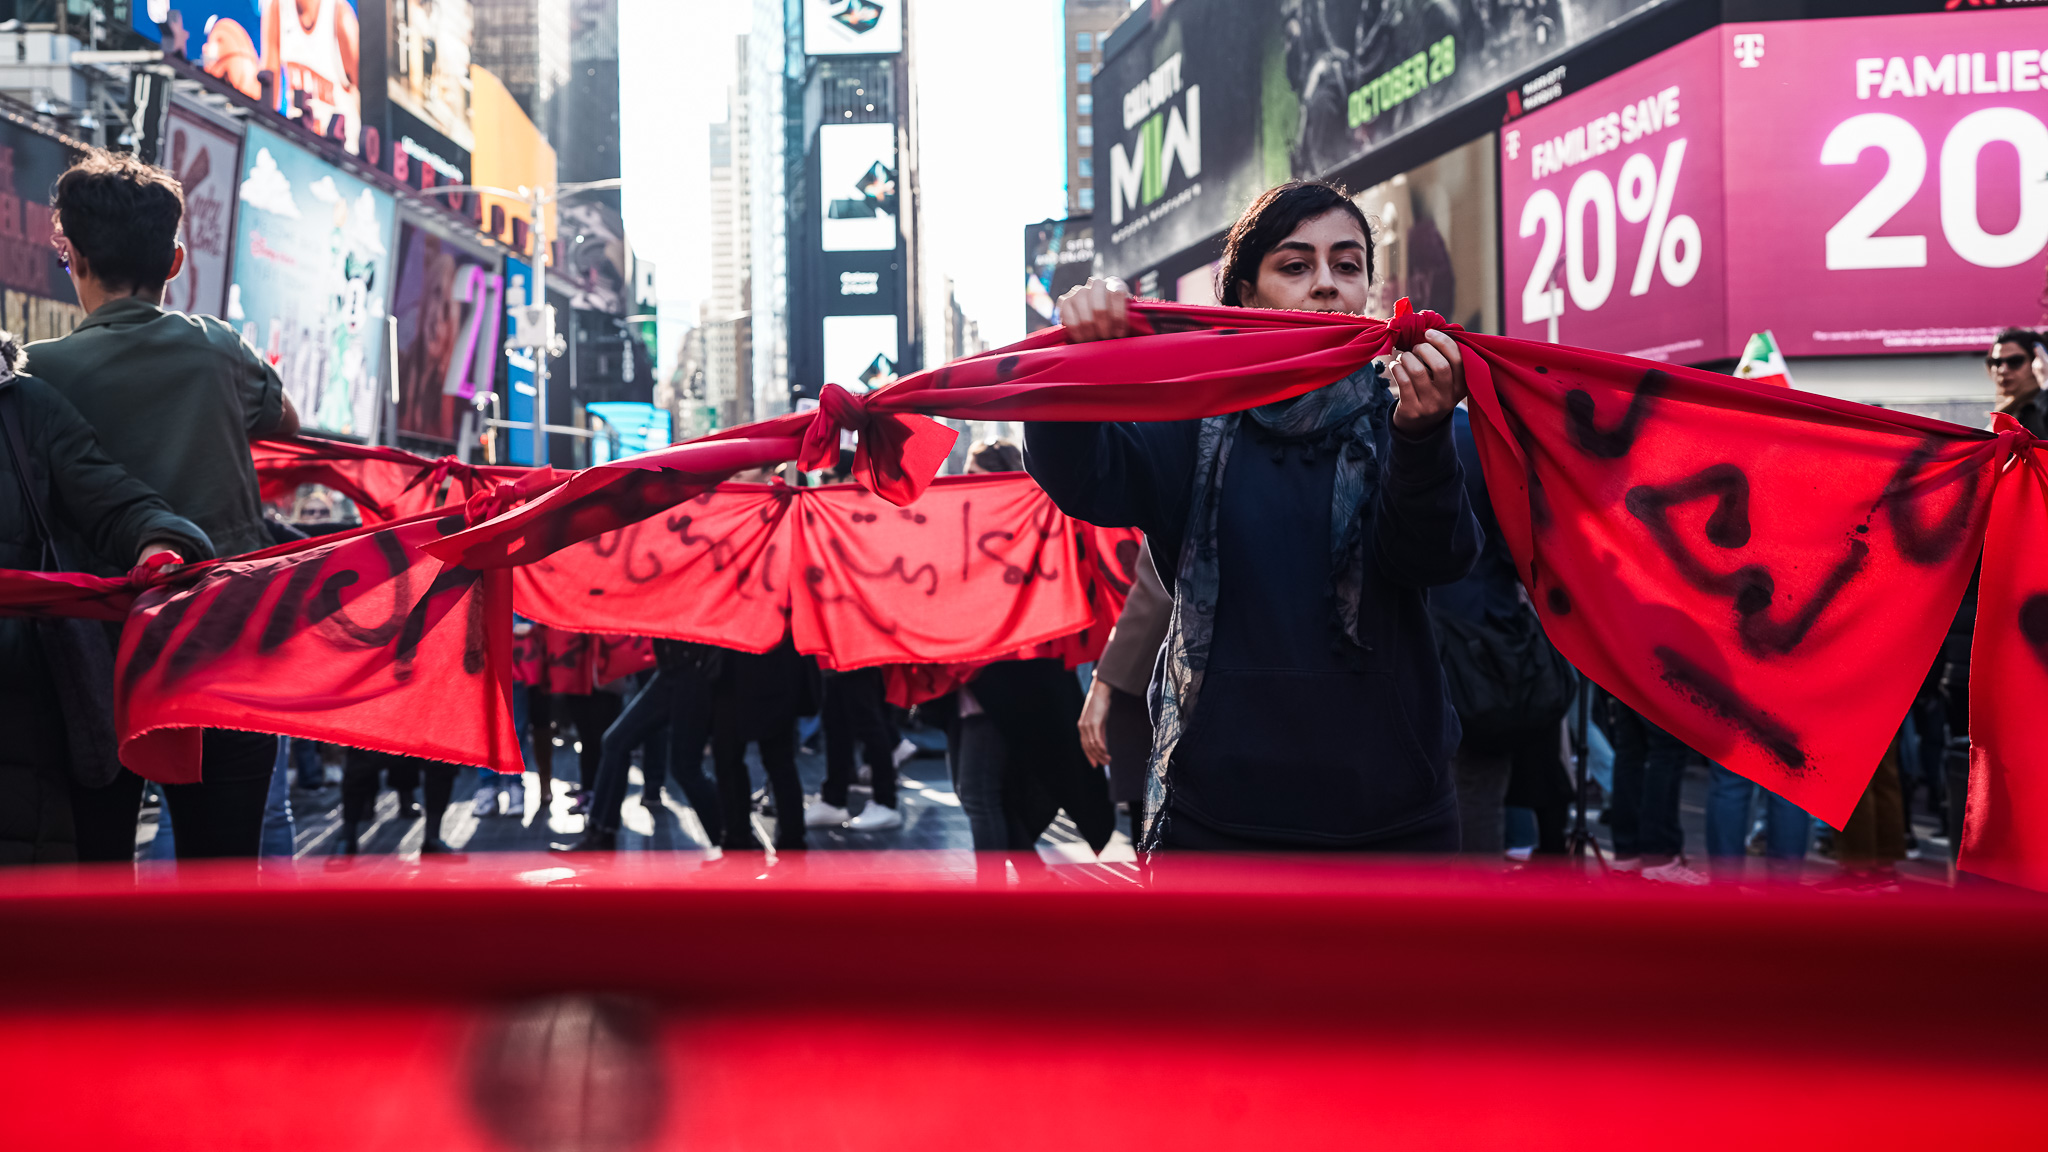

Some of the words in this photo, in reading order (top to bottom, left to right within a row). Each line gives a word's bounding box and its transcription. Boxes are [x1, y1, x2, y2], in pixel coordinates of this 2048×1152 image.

[1348, 51, 1429, 129] OCTOBER
[1429, 34, 1455, 84] 28
[1856, 48, 2048, 99] FAMILIE
[1532, 112, 1620, 180] FAMILIES
[1621, 85, 1681, 144] SAVE
[1519, 138, 1702, 324] 20%
[1820, 107, 2048, 270] 20
